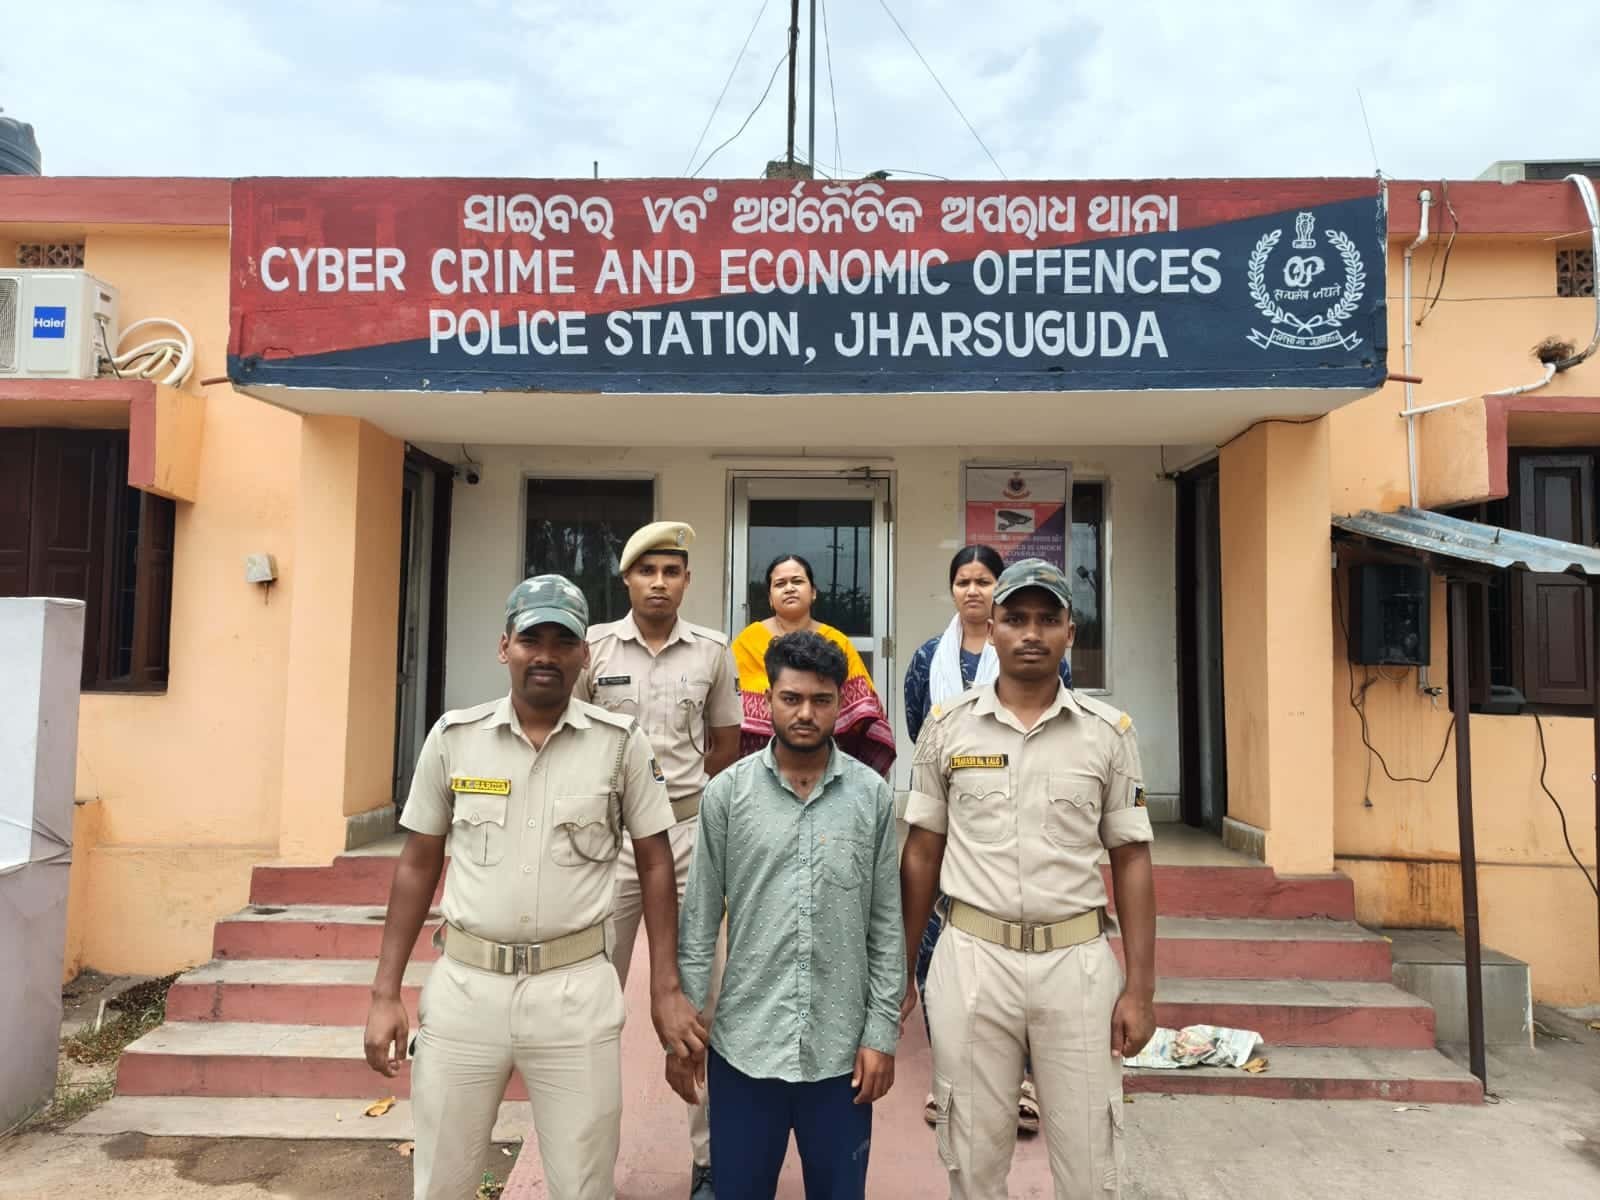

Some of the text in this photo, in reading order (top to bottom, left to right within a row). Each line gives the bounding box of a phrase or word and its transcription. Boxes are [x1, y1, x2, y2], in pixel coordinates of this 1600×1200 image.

[464, 181, 1178, 240] ସାଇବର ଏବଂ ଆର୍ଥନୈତିକ ଅପରାଧ ଥାନା
[260, 246, 1222, 295] CYBER CRIME AND ECONOMIC OFFENCES
[34, 318, 65, 328] Haier
[429, 309, 1169, 364] POLICE STATION, JHARSUGUDA
